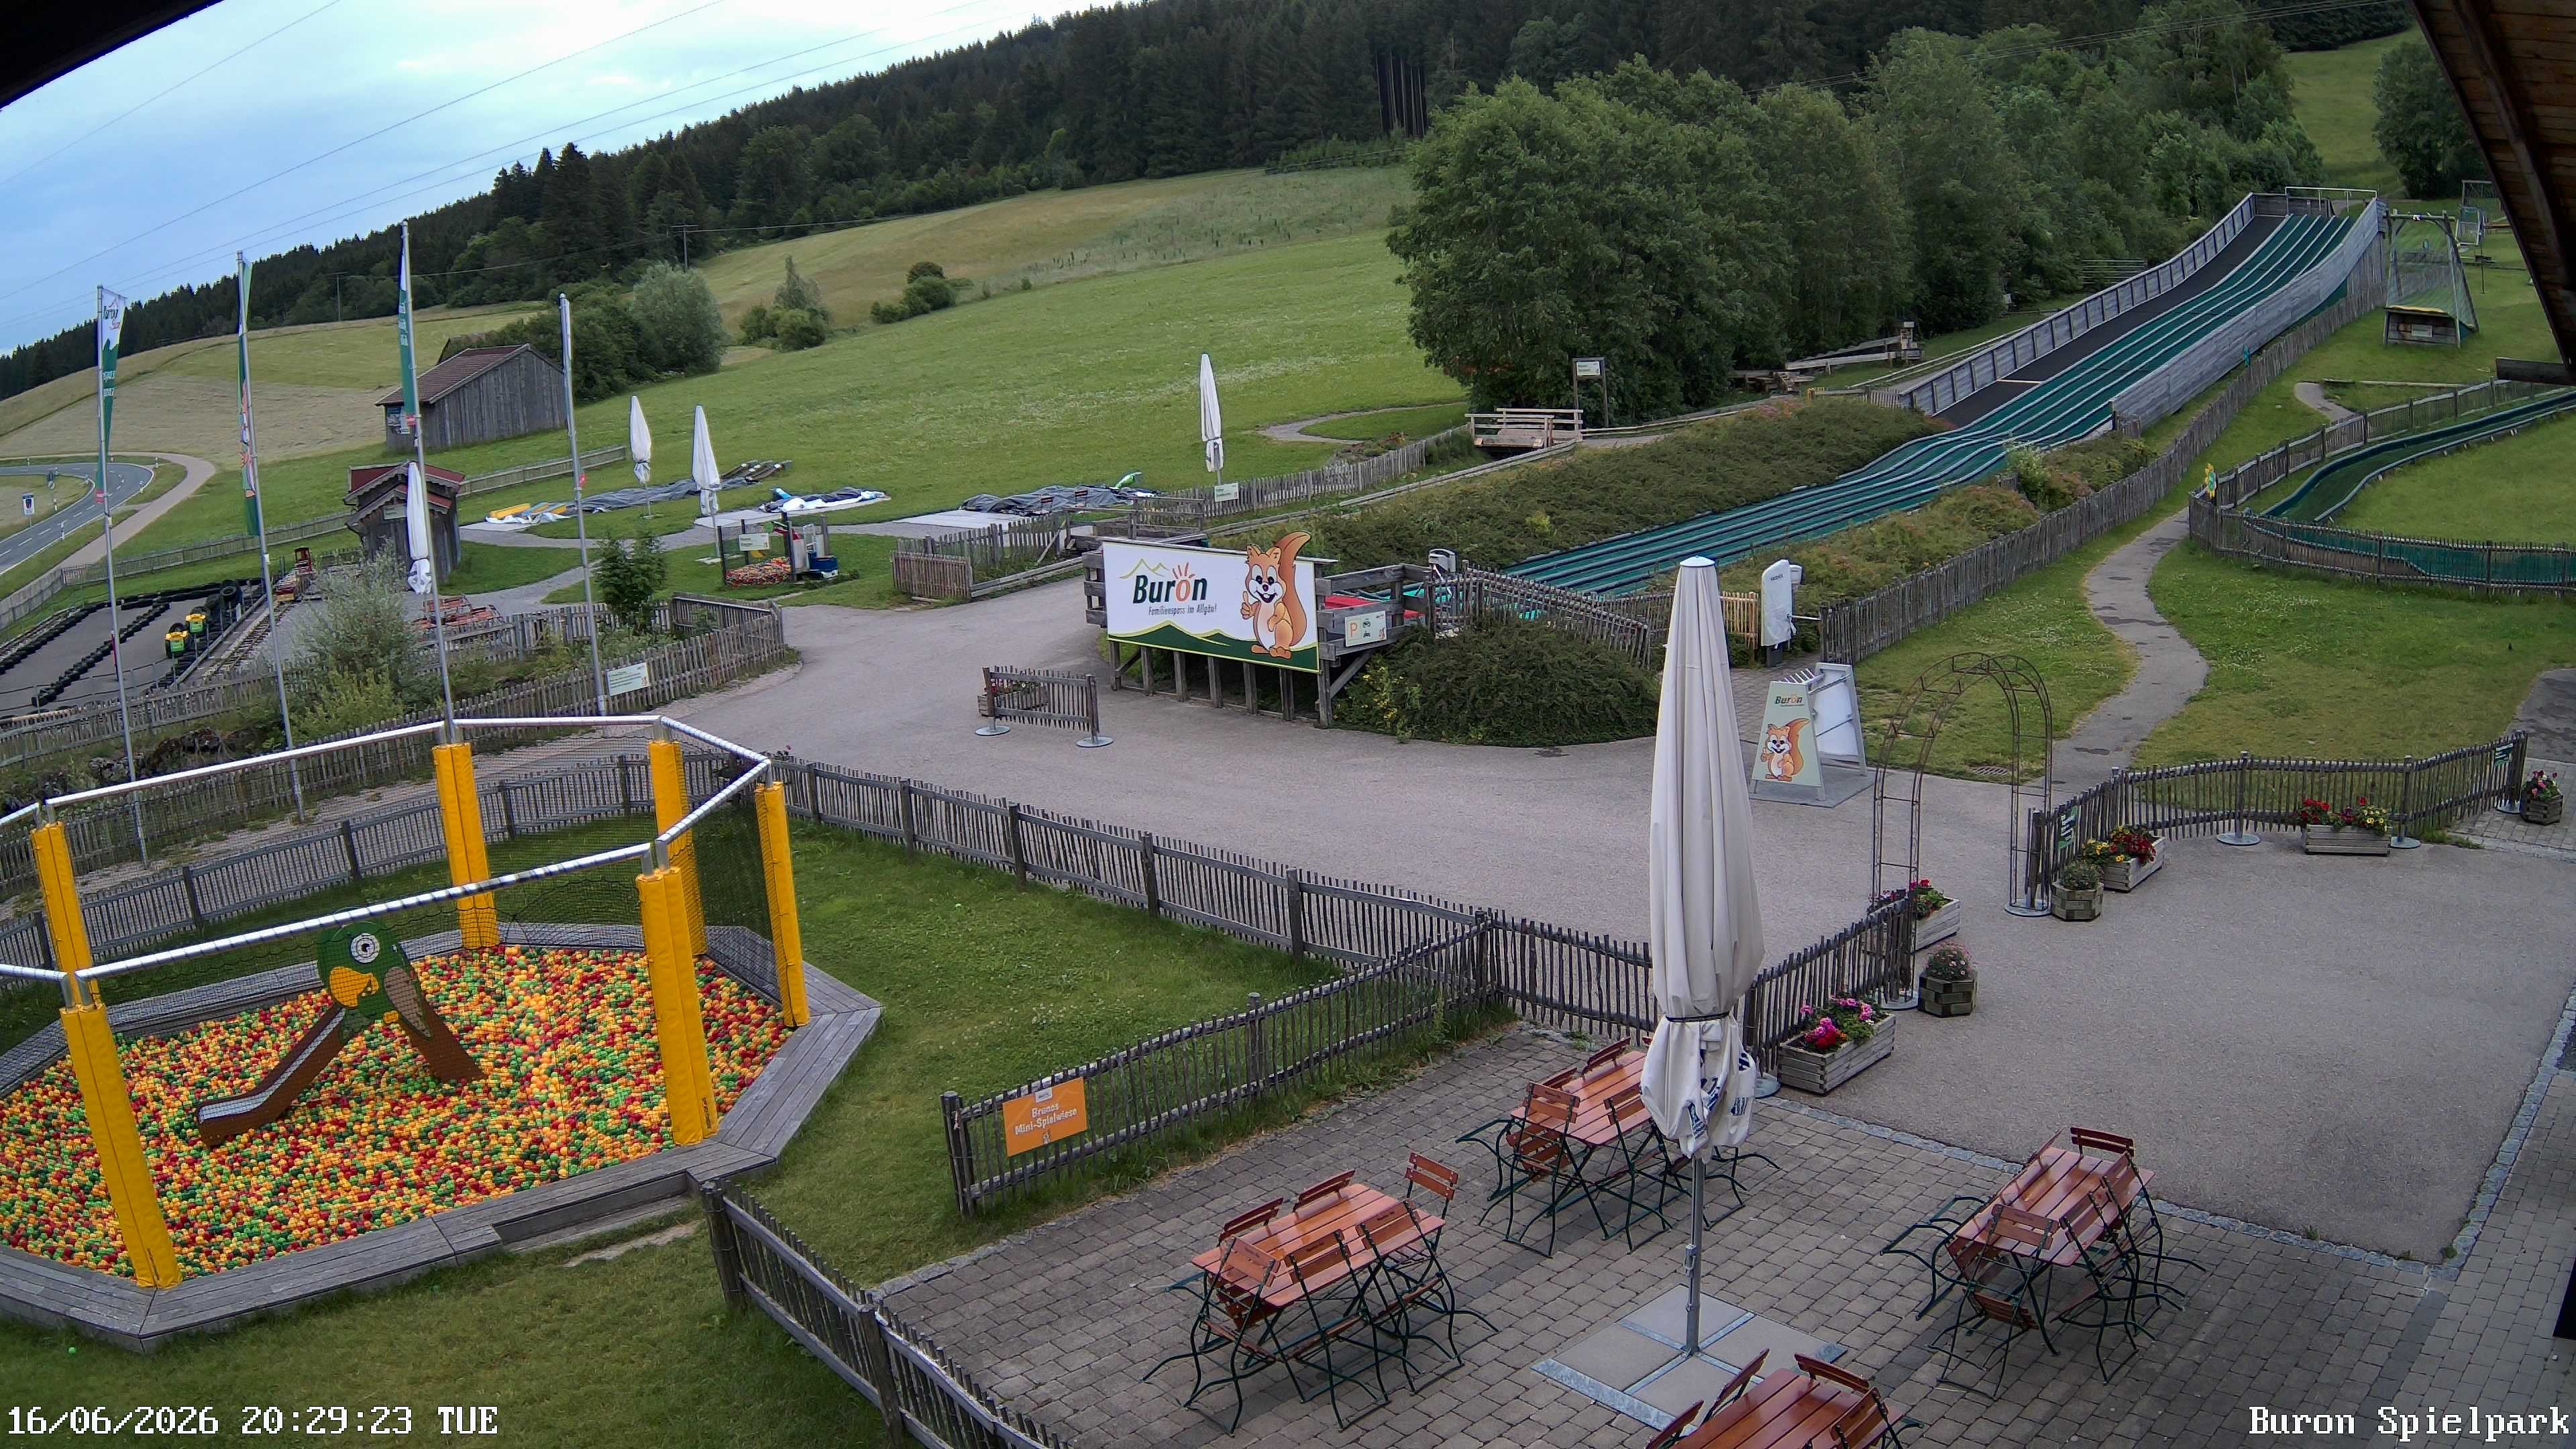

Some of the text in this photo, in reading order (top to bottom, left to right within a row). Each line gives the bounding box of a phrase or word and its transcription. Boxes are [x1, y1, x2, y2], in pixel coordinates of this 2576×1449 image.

[1133, 575, 1208, 604] Buron
[1187, 605, 1195, 614] im
[1350, 623, 1358, 638] P
[1775, 696, 1803, 704] Buron
